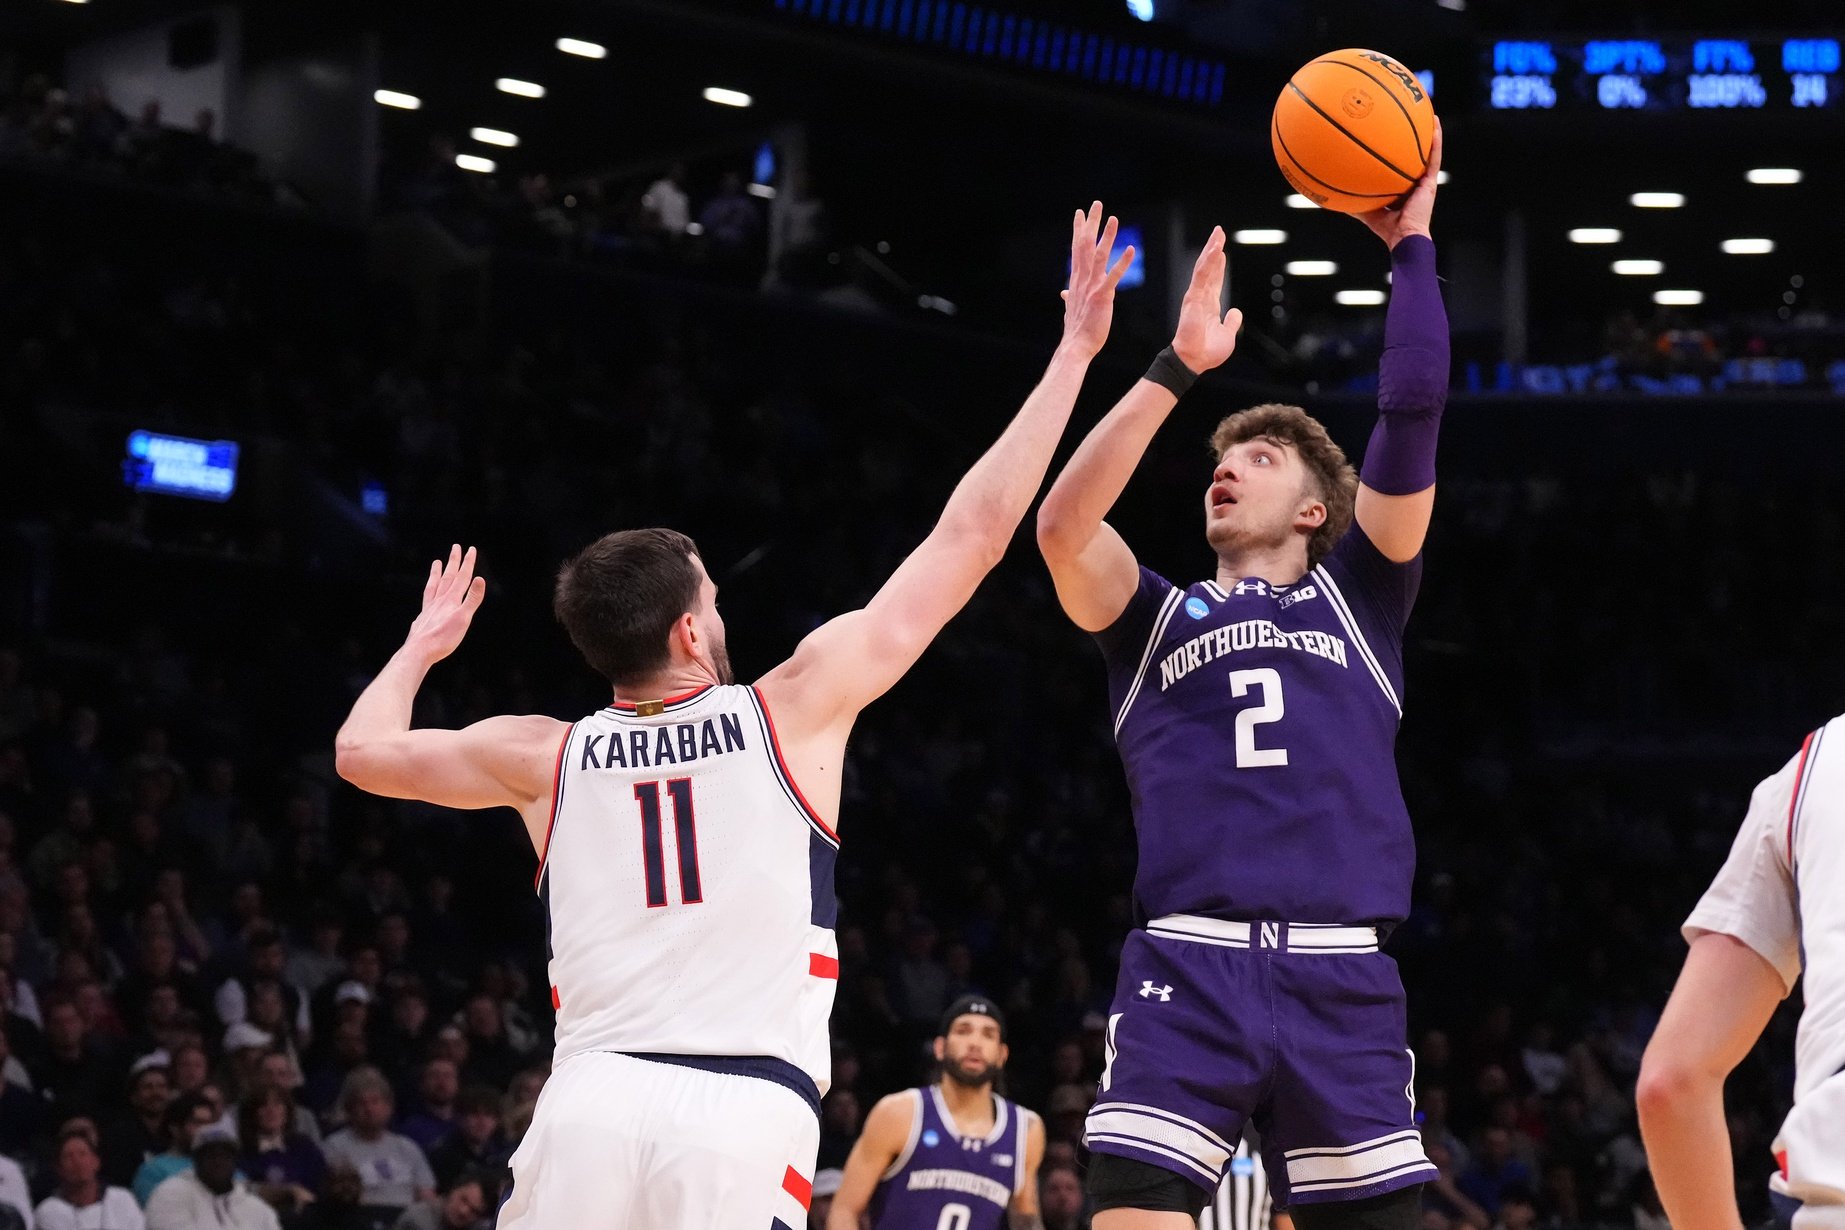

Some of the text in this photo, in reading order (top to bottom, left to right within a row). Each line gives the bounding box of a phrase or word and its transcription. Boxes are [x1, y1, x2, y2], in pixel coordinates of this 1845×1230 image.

[1358, 53, 1423, 103] NCAA
[1160, 620, 1348, 692] NORTHWESTERN
[581, 713, 746, 770] KARABAN
[1229, 668, 1288, 768] 2
[633, 777, 703, 908] 11
[1260, 922, 1279, 949] N
